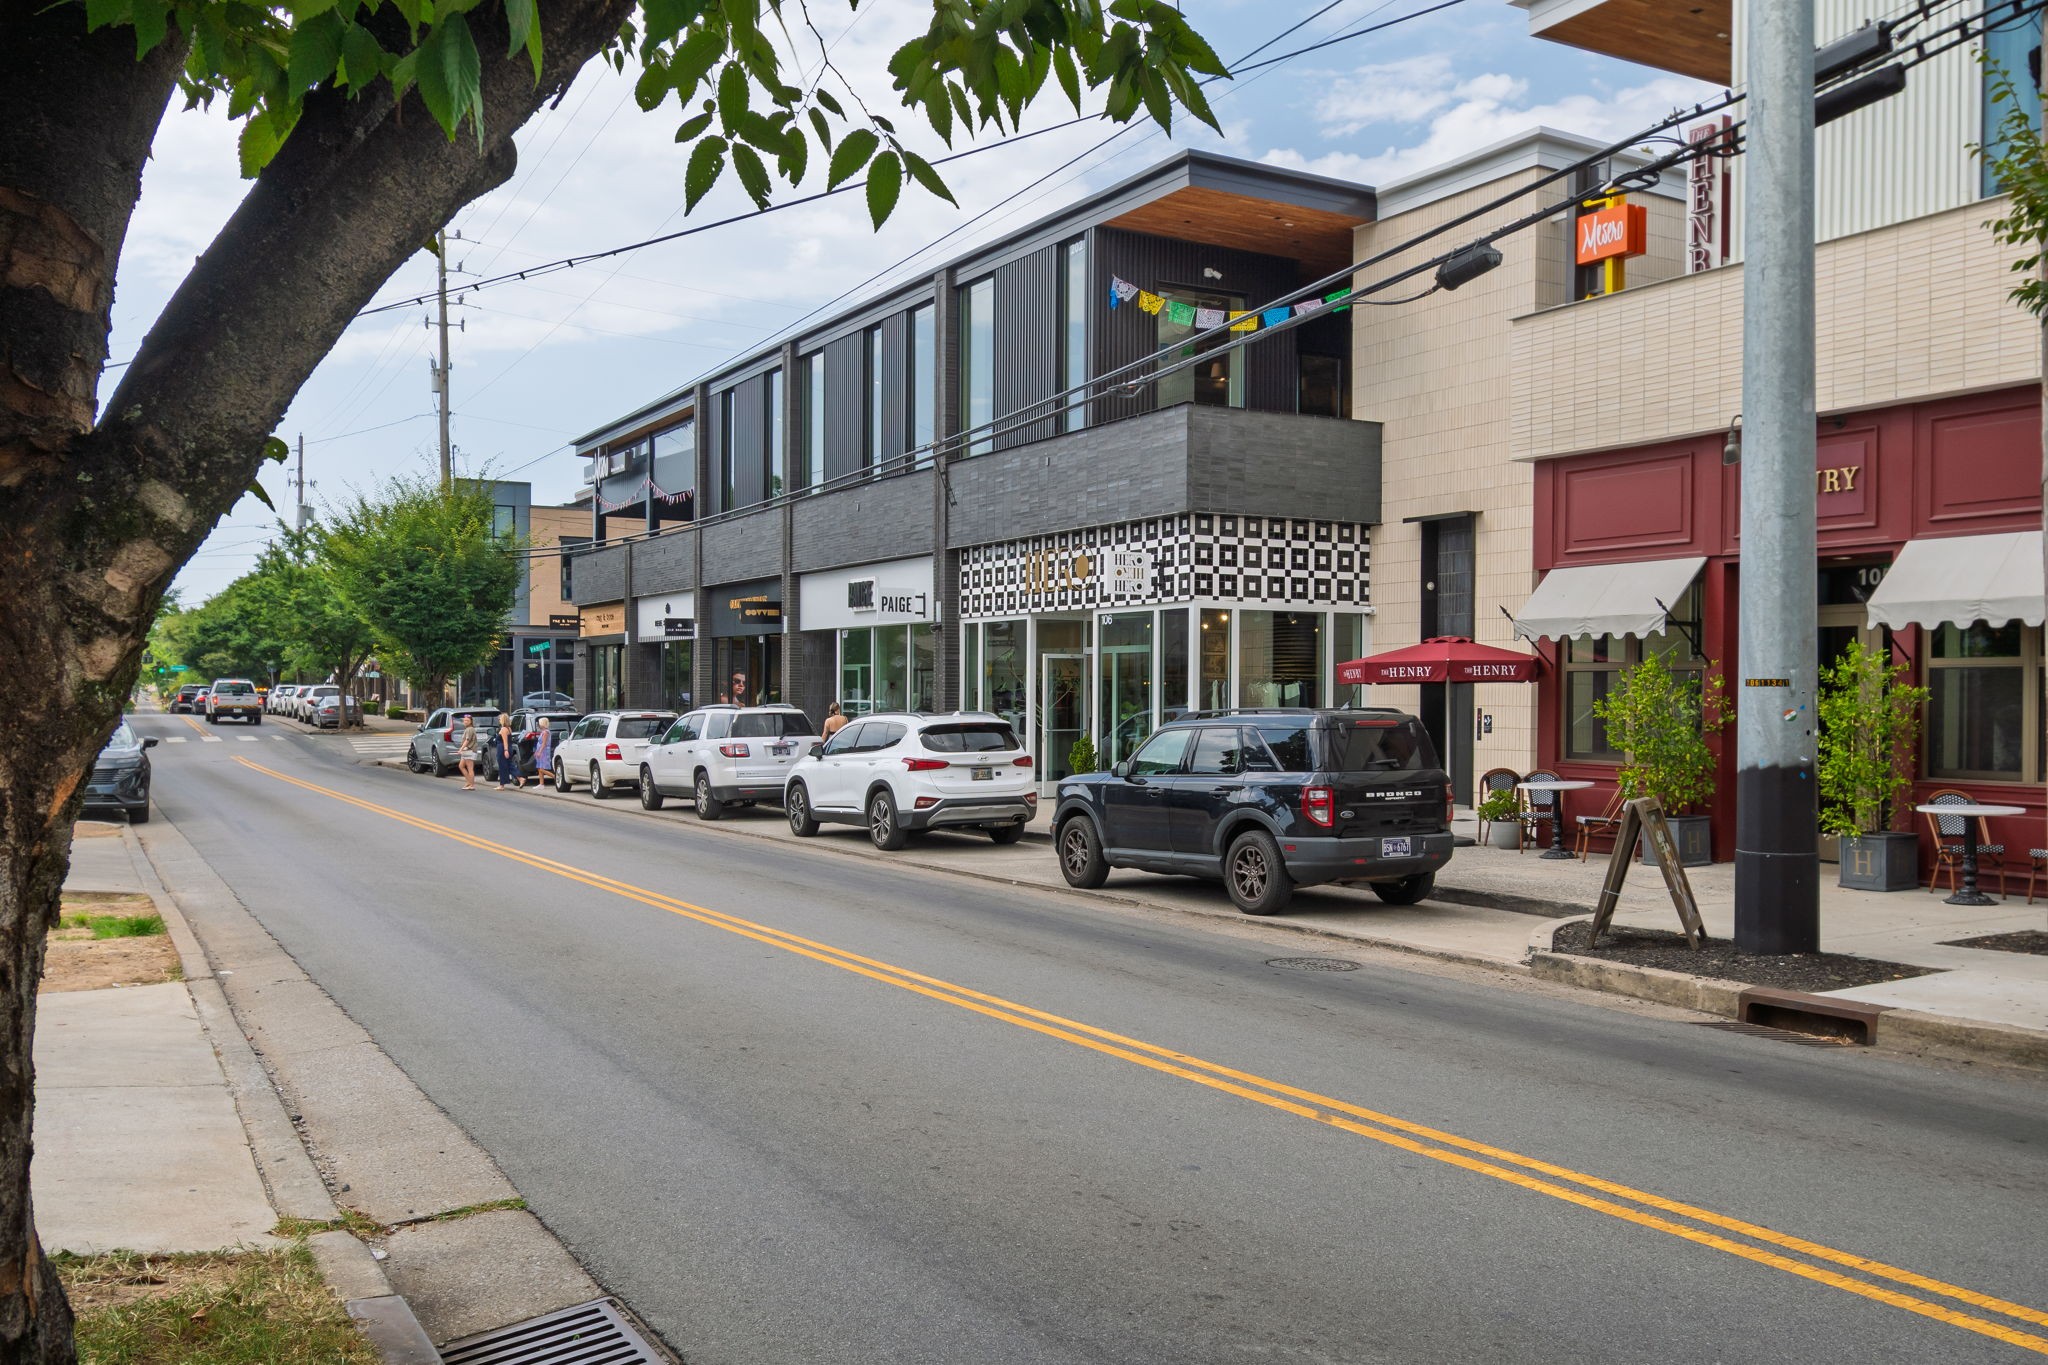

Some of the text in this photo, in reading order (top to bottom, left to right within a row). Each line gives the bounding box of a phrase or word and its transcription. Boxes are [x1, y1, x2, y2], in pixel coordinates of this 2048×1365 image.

[1691, 126, 1711, 143] THE
[1581, 216, 1624, 254] Mesero
[1816, 466, 1859, 494] RY
[1024, 543, 1094, 594] HERO
[881, 596, 912, 613] PAIGE
[1101, 614, 1113, 625] 106
[1389, 666, 1432, 678] HENRY
[1473, 664, 1517, 676] HENRY
[1687, 831, 1701, 854] H
[1853, 849, 1874, 877] H
